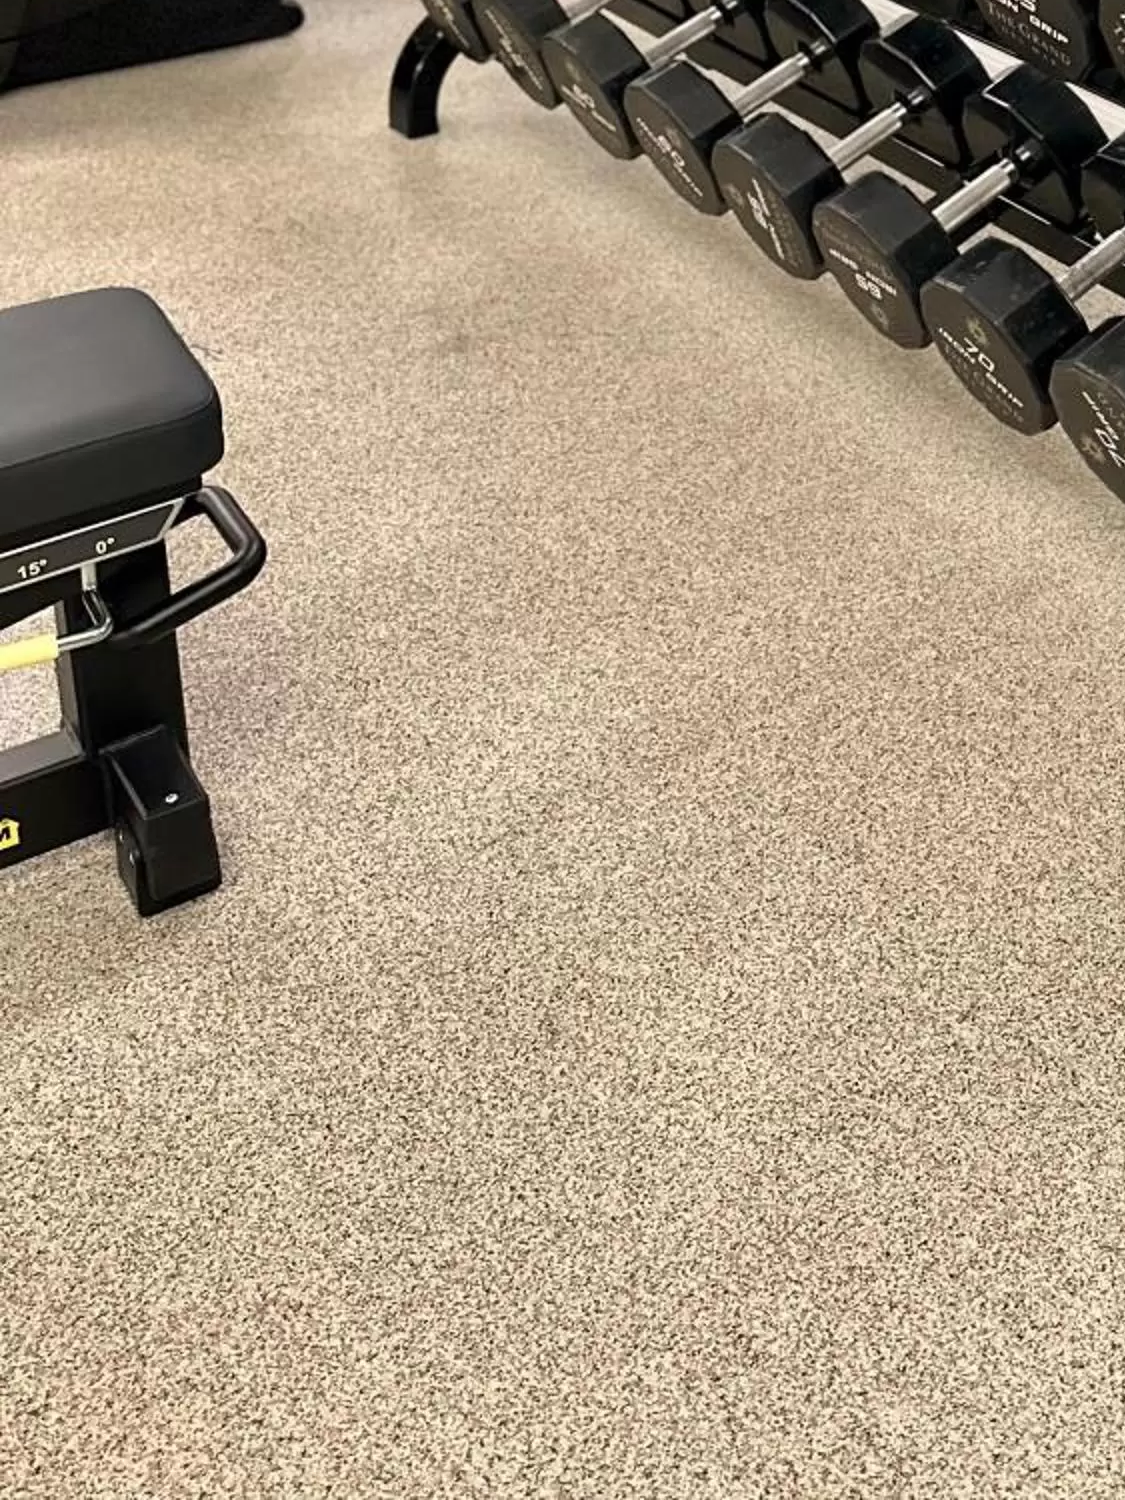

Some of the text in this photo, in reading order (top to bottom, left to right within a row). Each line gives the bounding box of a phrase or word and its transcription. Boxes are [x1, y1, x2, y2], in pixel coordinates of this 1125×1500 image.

[1028, 14, 1070, 45] GRIP
[855, 271, 883, 300] 65
[938, 326, 1024, 408] IRON GRIP
[963, 336, 996, 372] 70
[1081, 390, 1120, 442] GRIP
[95, 537, 116, 555] 0°
[16, 559, 47, 581] 15°
